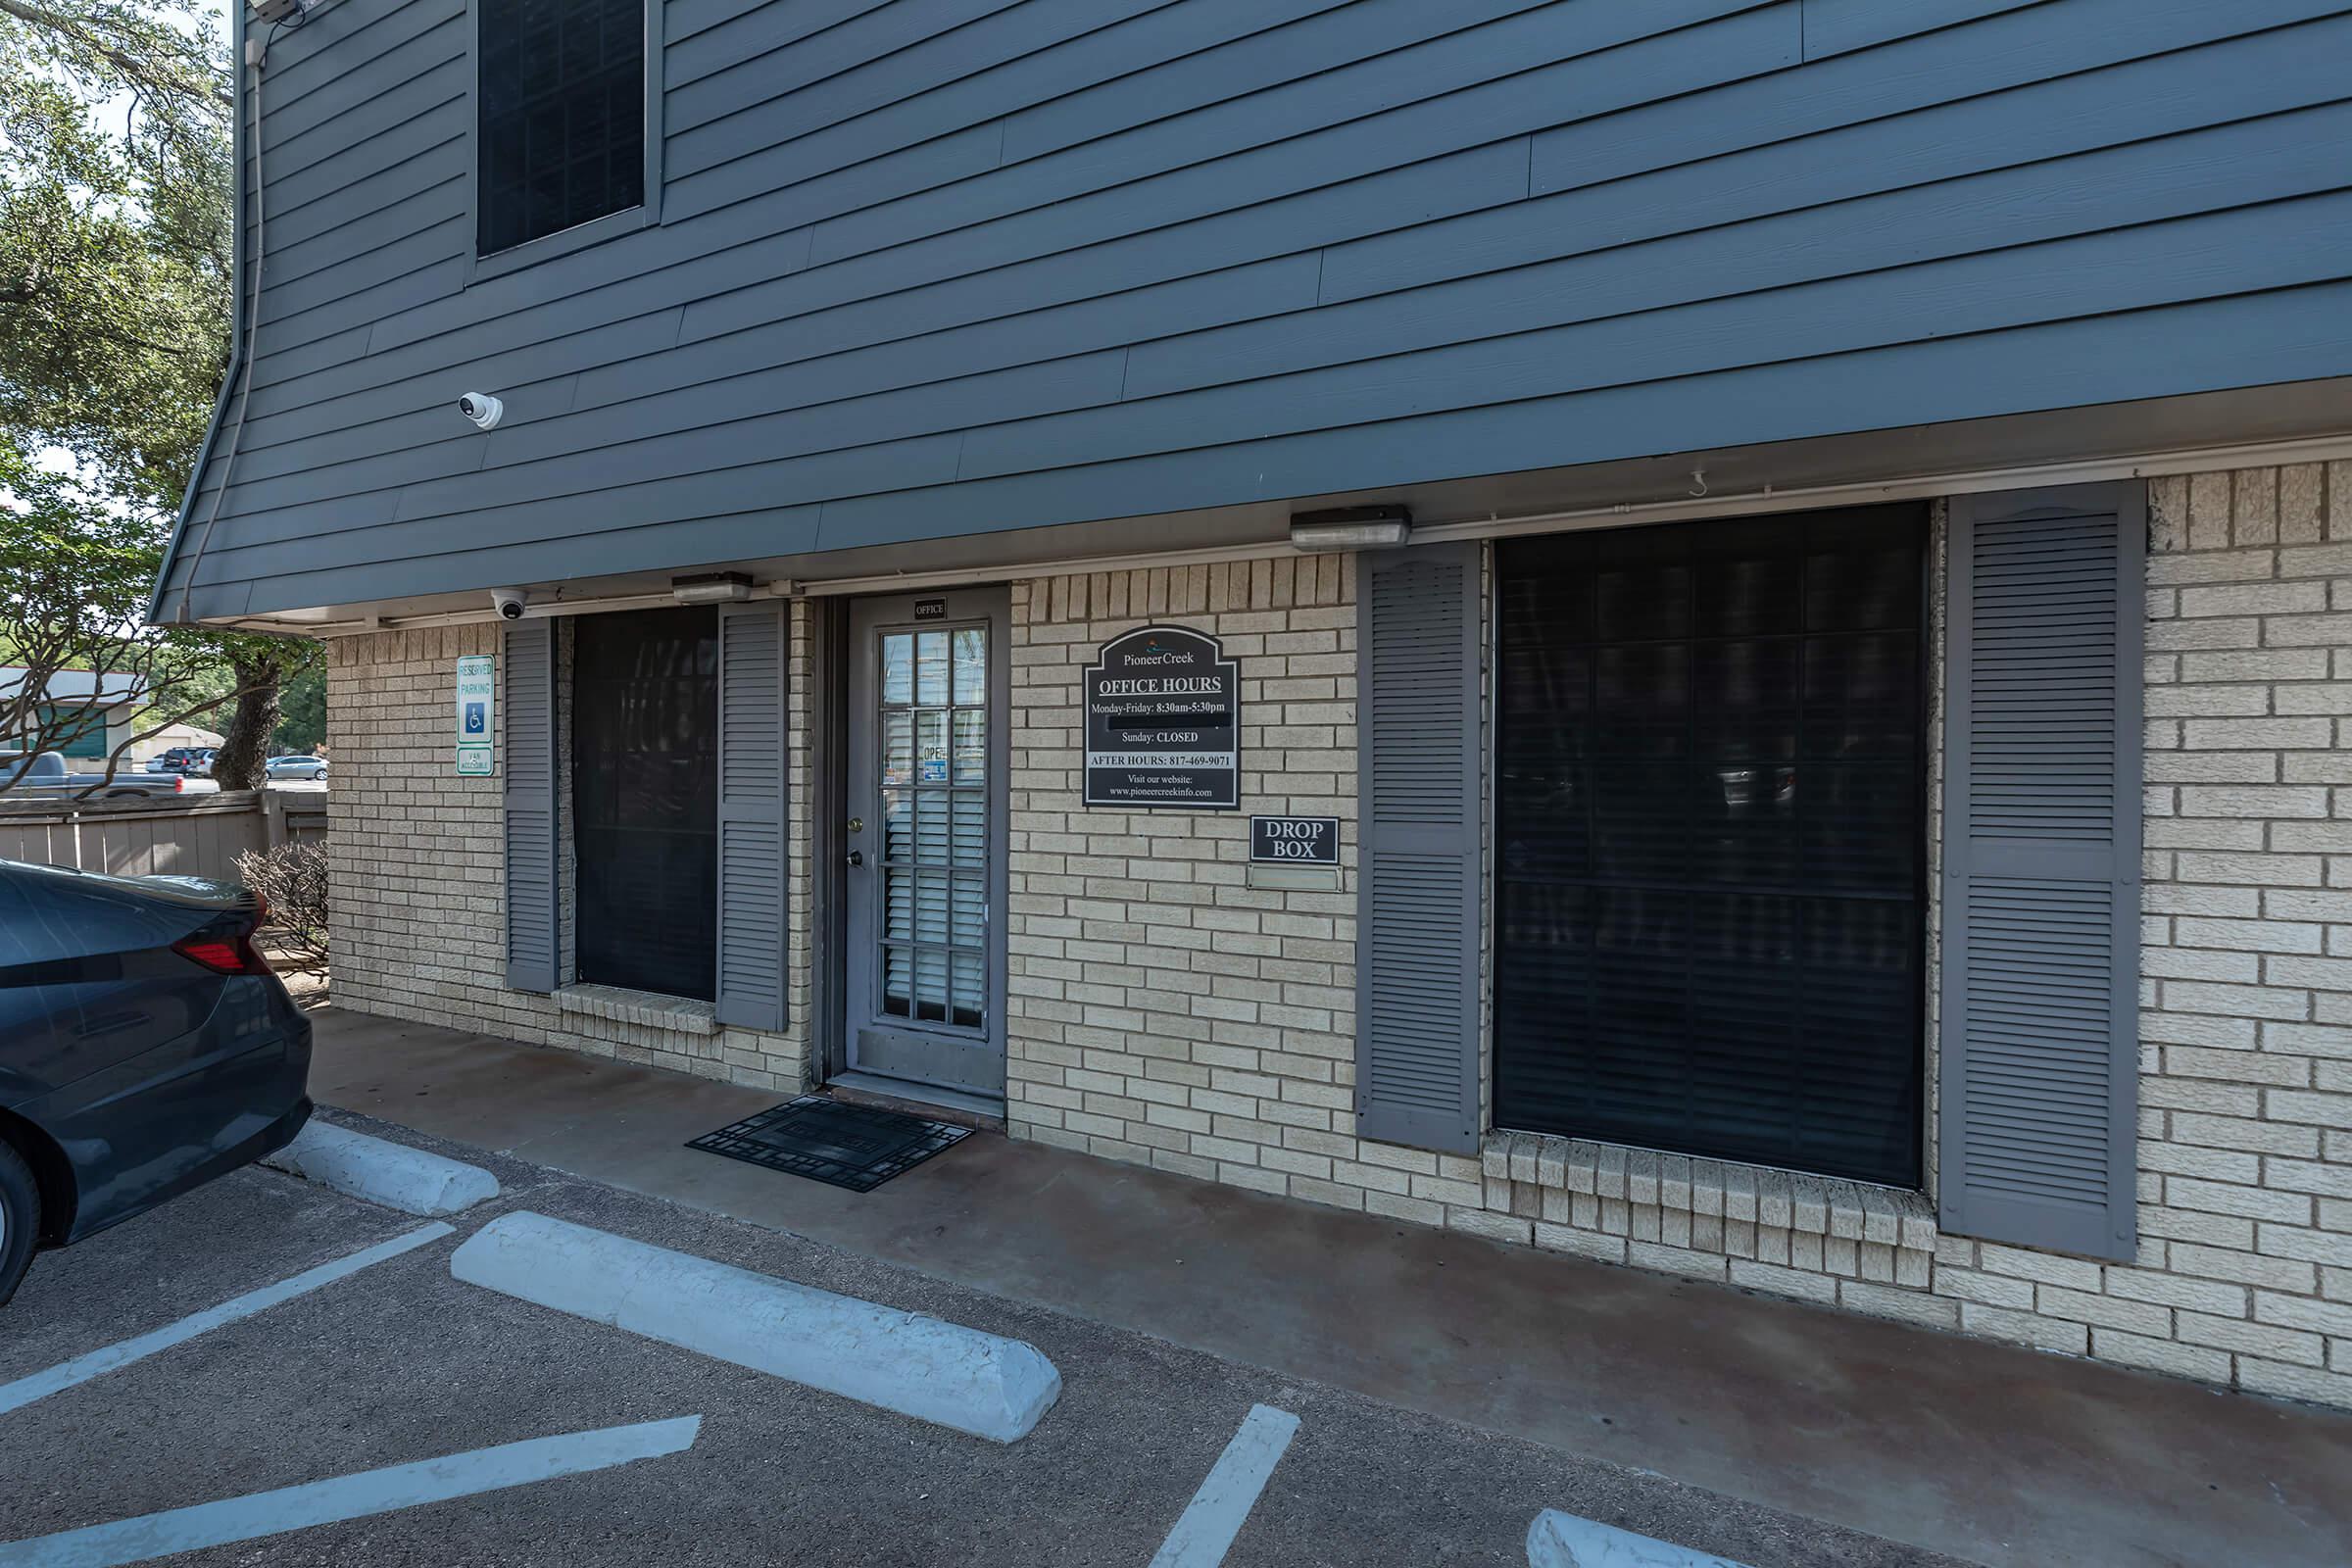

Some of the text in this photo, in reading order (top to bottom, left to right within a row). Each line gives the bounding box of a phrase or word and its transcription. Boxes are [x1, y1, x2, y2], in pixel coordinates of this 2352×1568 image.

[916, 604, 944, 614] OFFICE
[1099, 676, 1222, 694] OFFICE HOURS
[1091, 702, 1225, 715] Monday-Friday: 8:30am-5:30pm
[1122, 732, 1199, 744] Sunday: CLOSED
[1091, 756, 1230, 765] AFTER HOURS: 817-469-9071
[1128, 774, 1146, 784] Visit
[1160, 775, 1193, 784] website:
[1109, 787, 1212, 798] www.pioneercreekinfo.com
[1264, 821, 1324, 840] DROP
[1272, 840, 1318, 858] BOX
